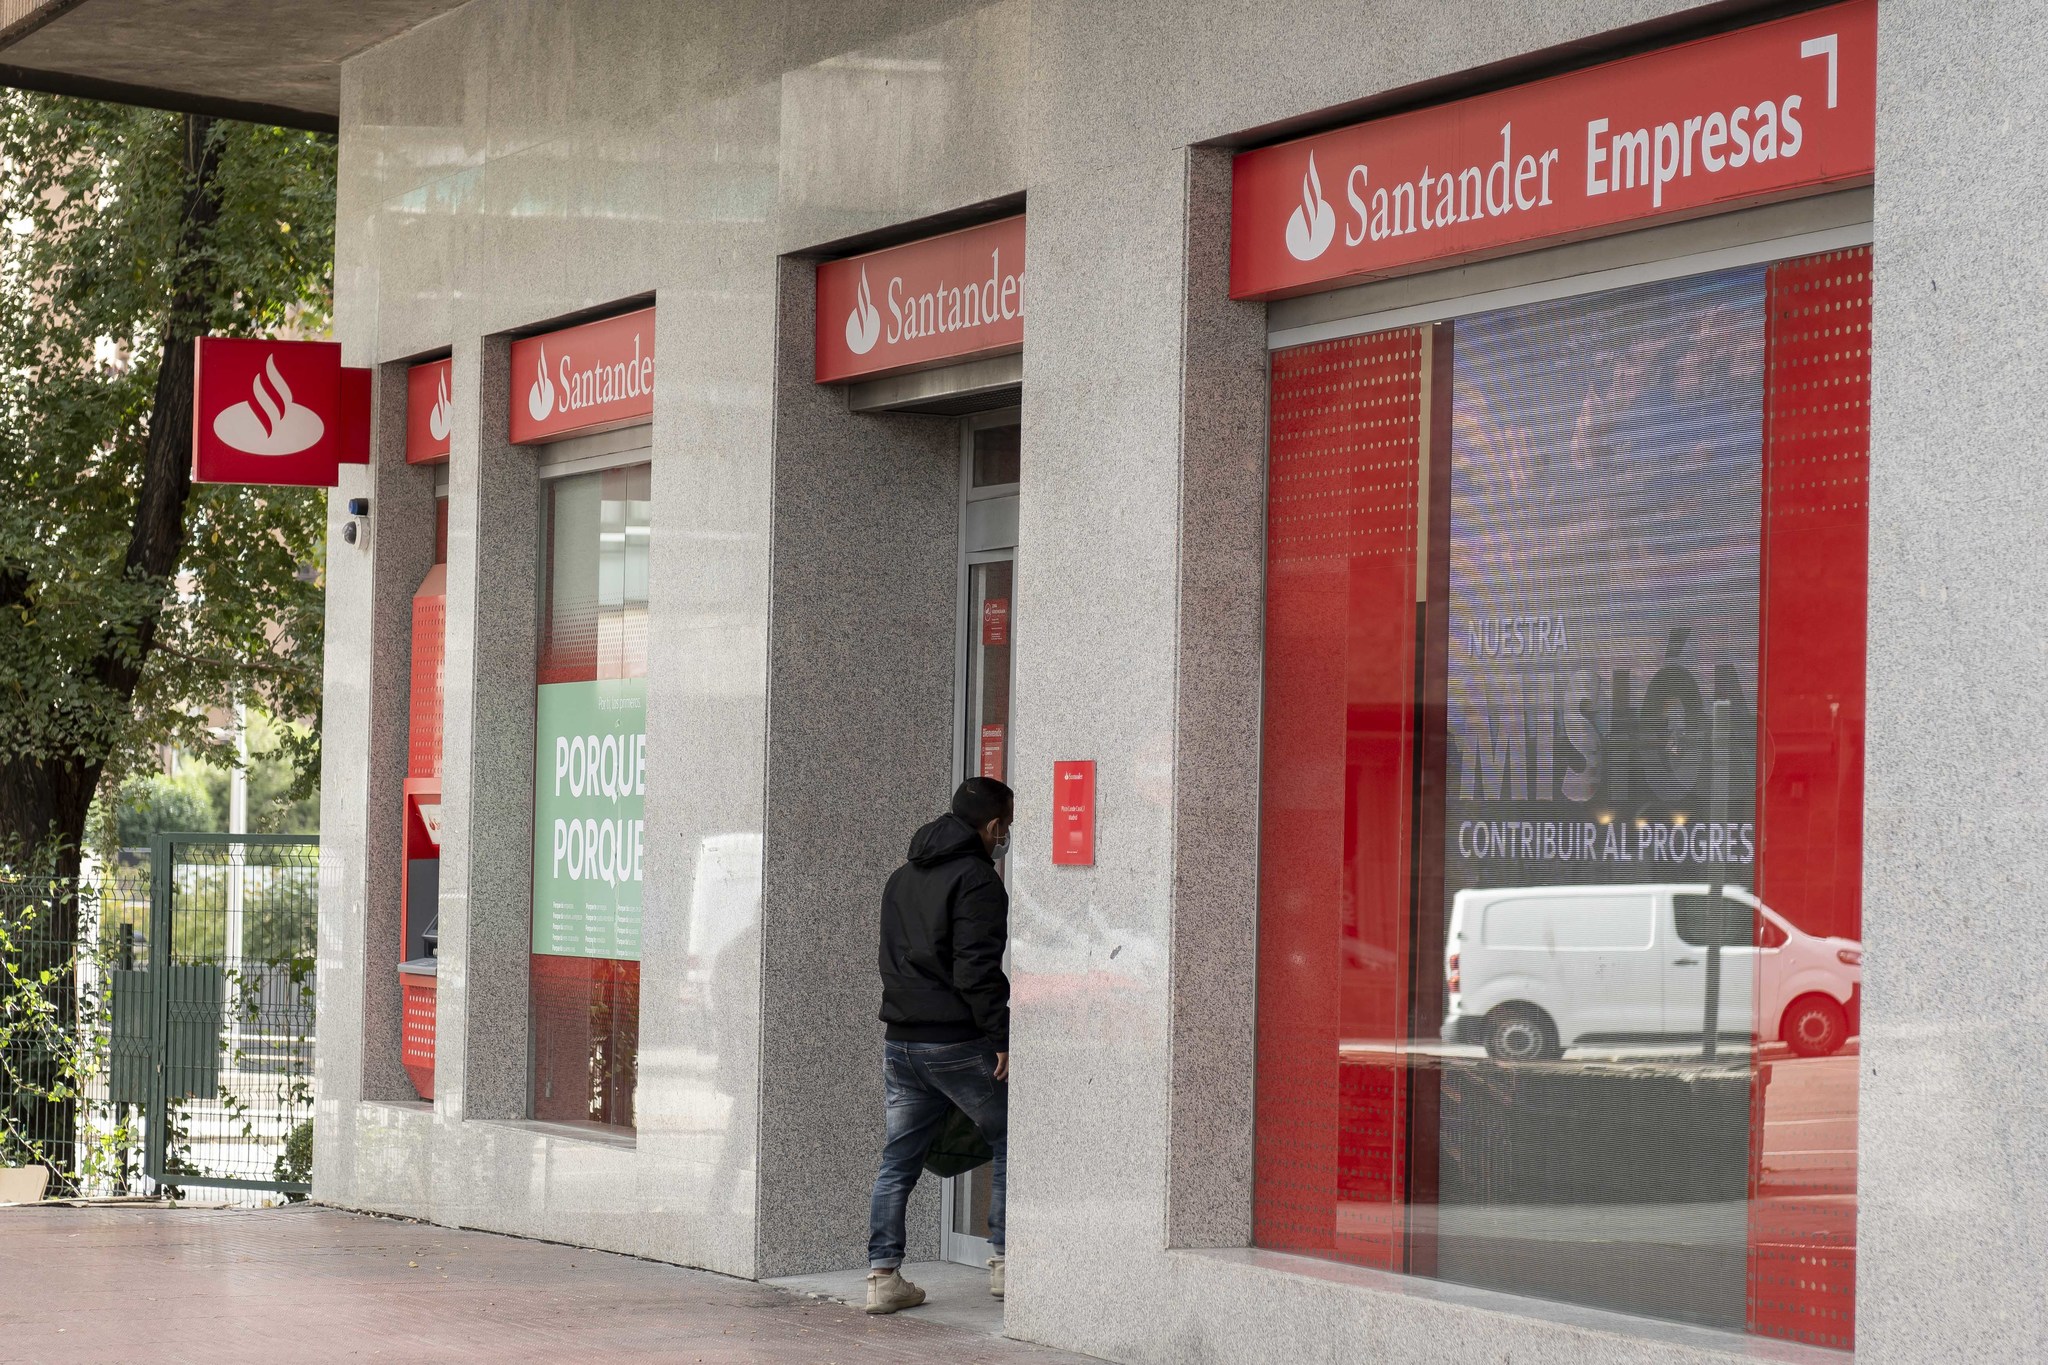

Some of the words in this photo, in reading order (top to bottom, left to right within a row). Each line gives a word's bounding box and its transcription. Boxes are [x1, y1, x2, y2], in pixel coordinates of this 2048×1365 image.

[1344, 121, 1559, 247] Santander
[1586, 94, 1803, 208] Empresas
[558, 332, 655, 413] Santande
[1467, 613, 1569, 657] NUESTRA
[555, 733, 646, 805] PORQUE
[553, 817, 644, 889] PORQUE
[1458, 820, 1597, 861] CONTRIBUIR
[1602, 822, 1632, 862] AL
[1638, 822, 1755, 864] PROGRES
